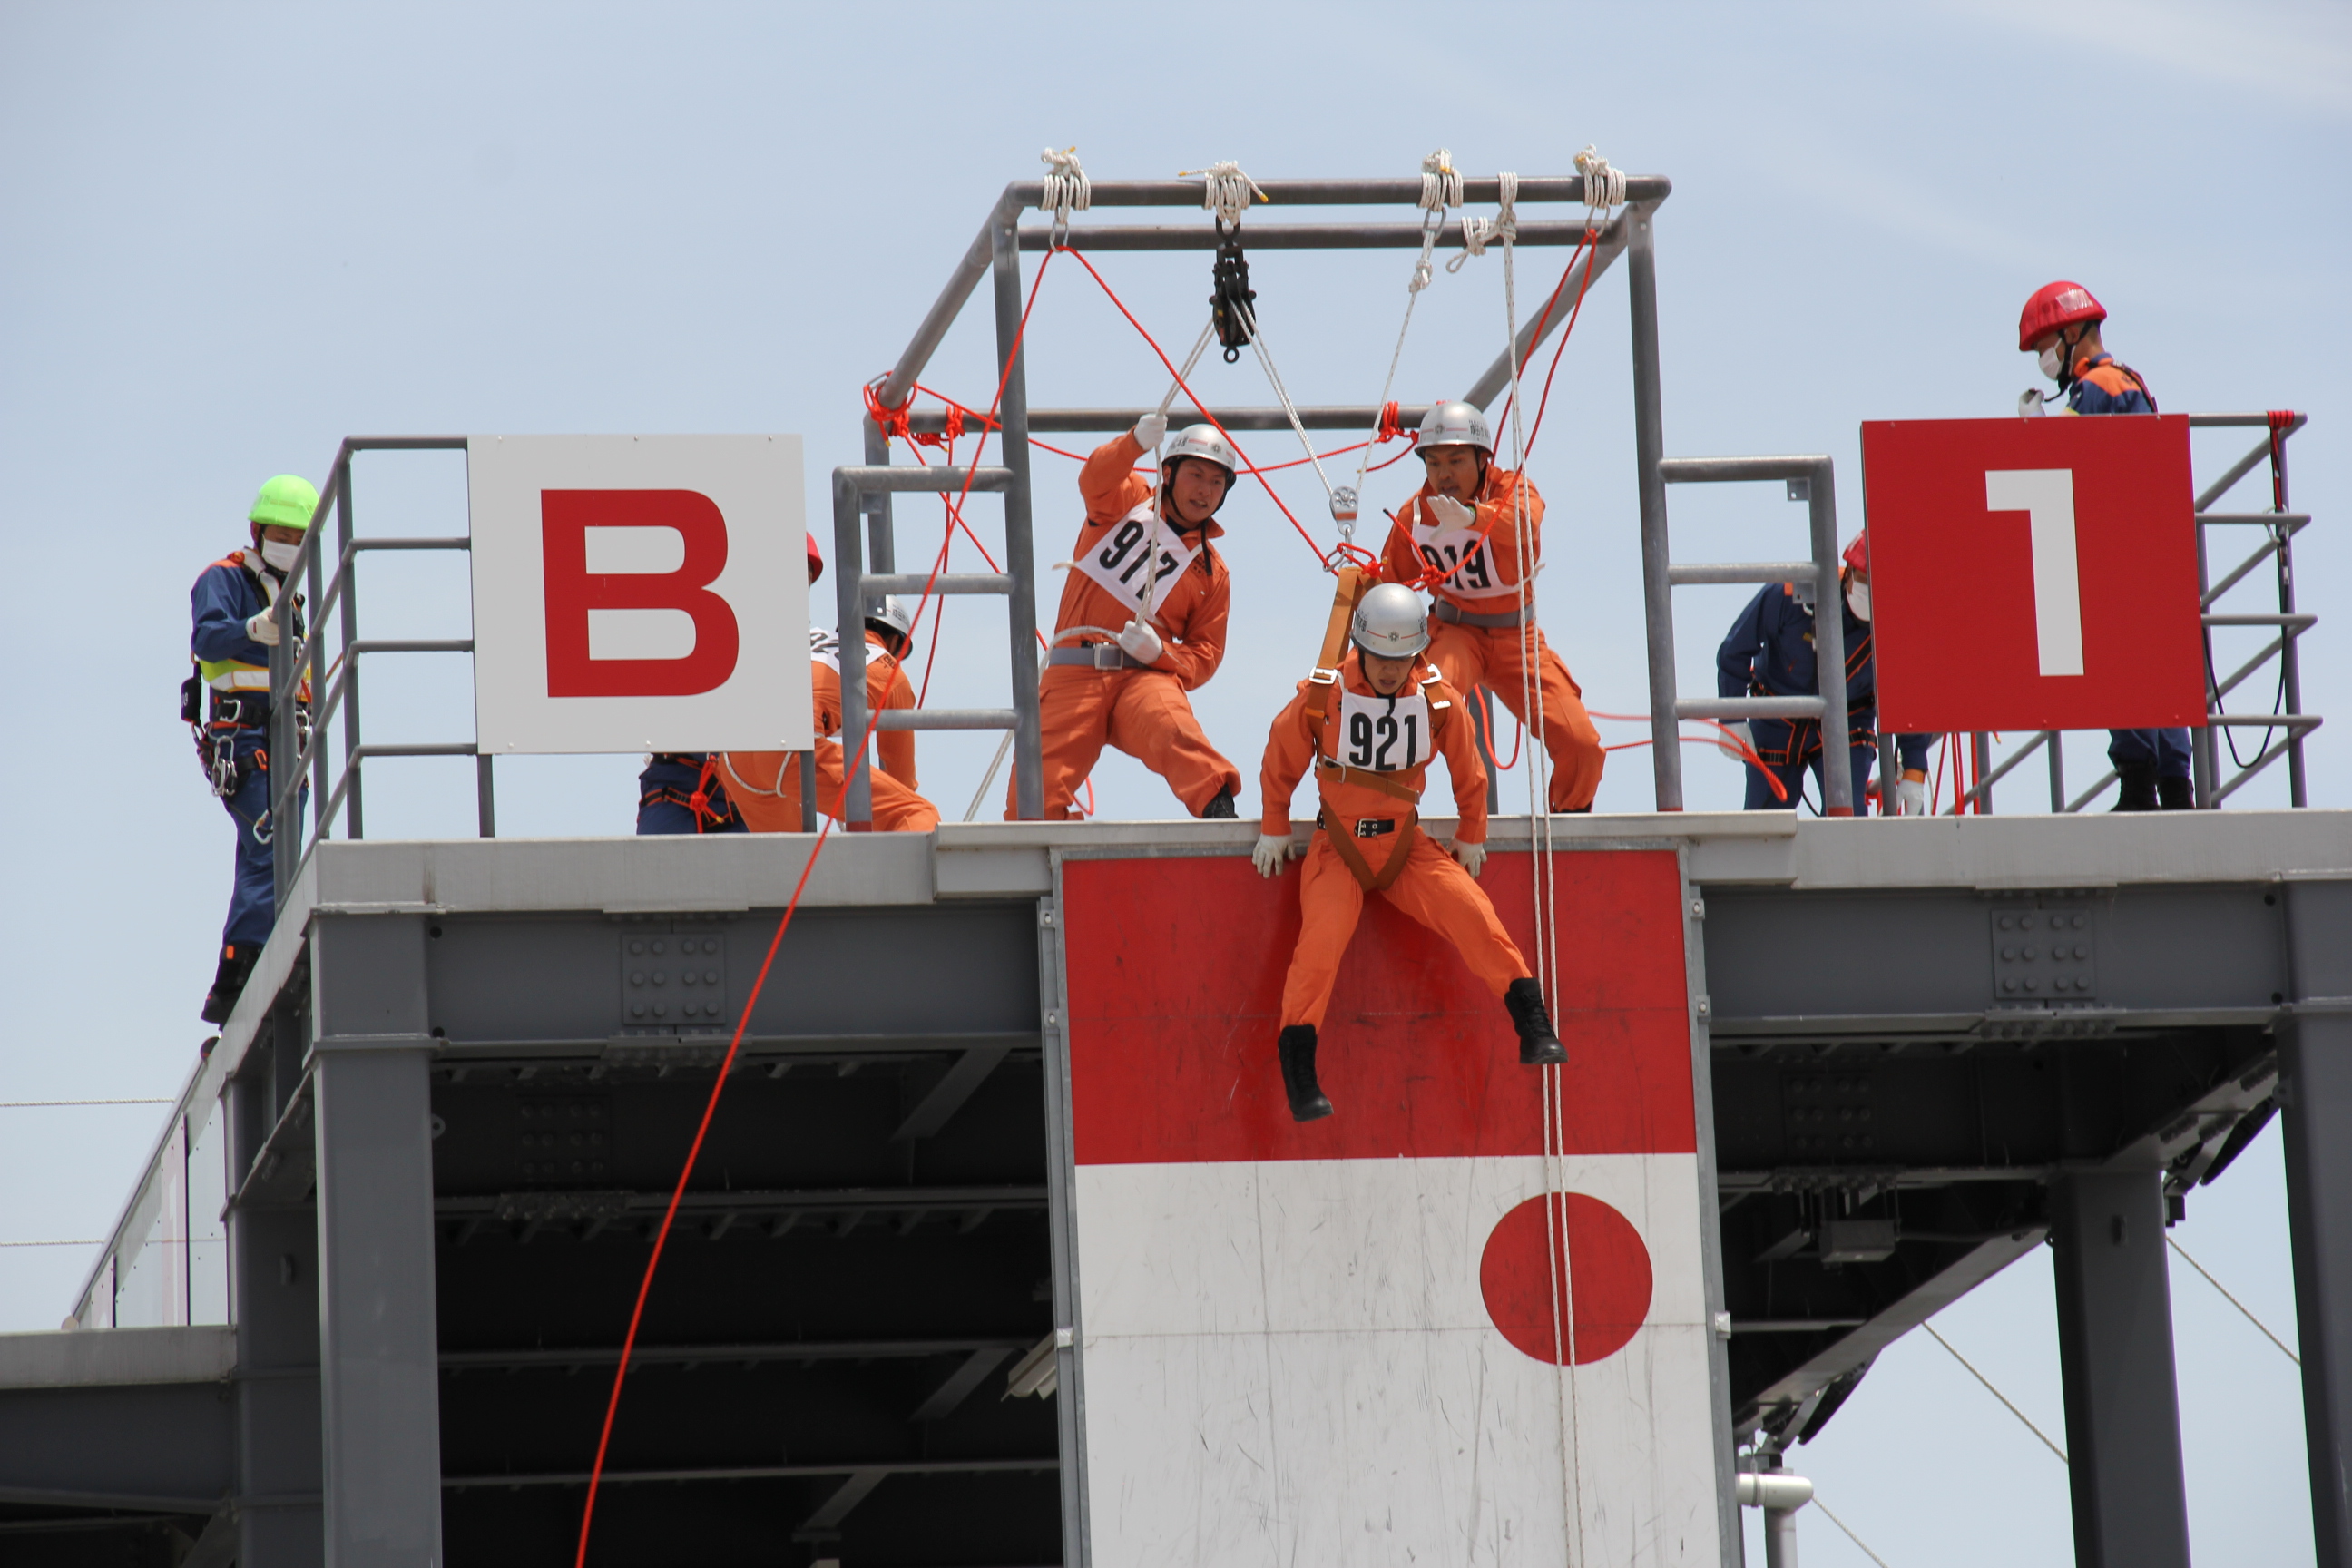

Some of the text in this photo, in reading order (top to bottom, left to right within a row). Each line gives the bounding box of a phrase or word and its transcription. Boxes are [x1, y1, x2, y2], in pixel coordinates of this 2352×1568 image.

[541, 489, 740, 698] B
[1099, 520, 1180, 601] 917
[1420, 540, 1492, 591] 919
[1985, 468, 2084, 677] 1
[1349, 711, 1417, 772] 921
